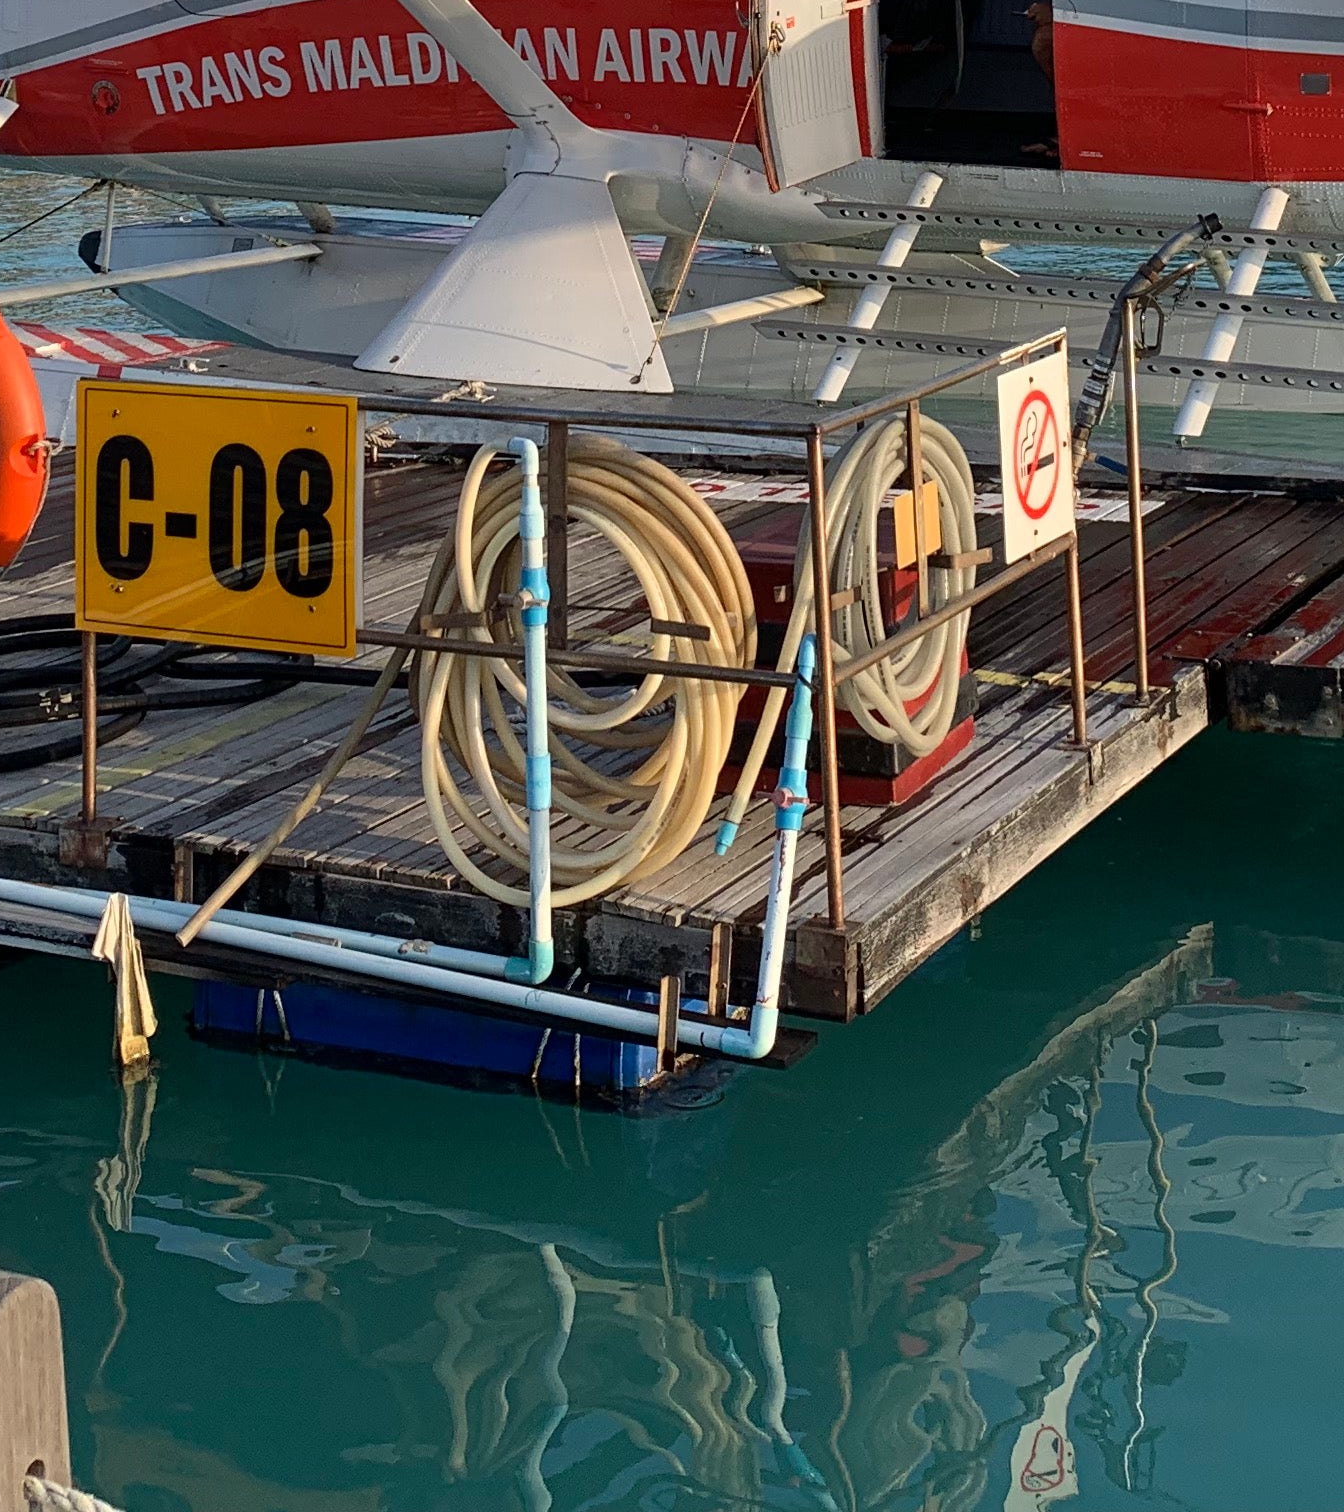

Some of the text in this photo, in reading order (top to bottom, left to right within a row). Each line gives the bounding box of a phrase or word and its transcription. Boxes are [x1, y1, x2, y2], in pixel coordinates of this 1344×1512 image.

[136, 44, 292, 116] TRANS
[301, 27, 581, 94] MALDIAN
[95, 434, 334, 599] C-08
